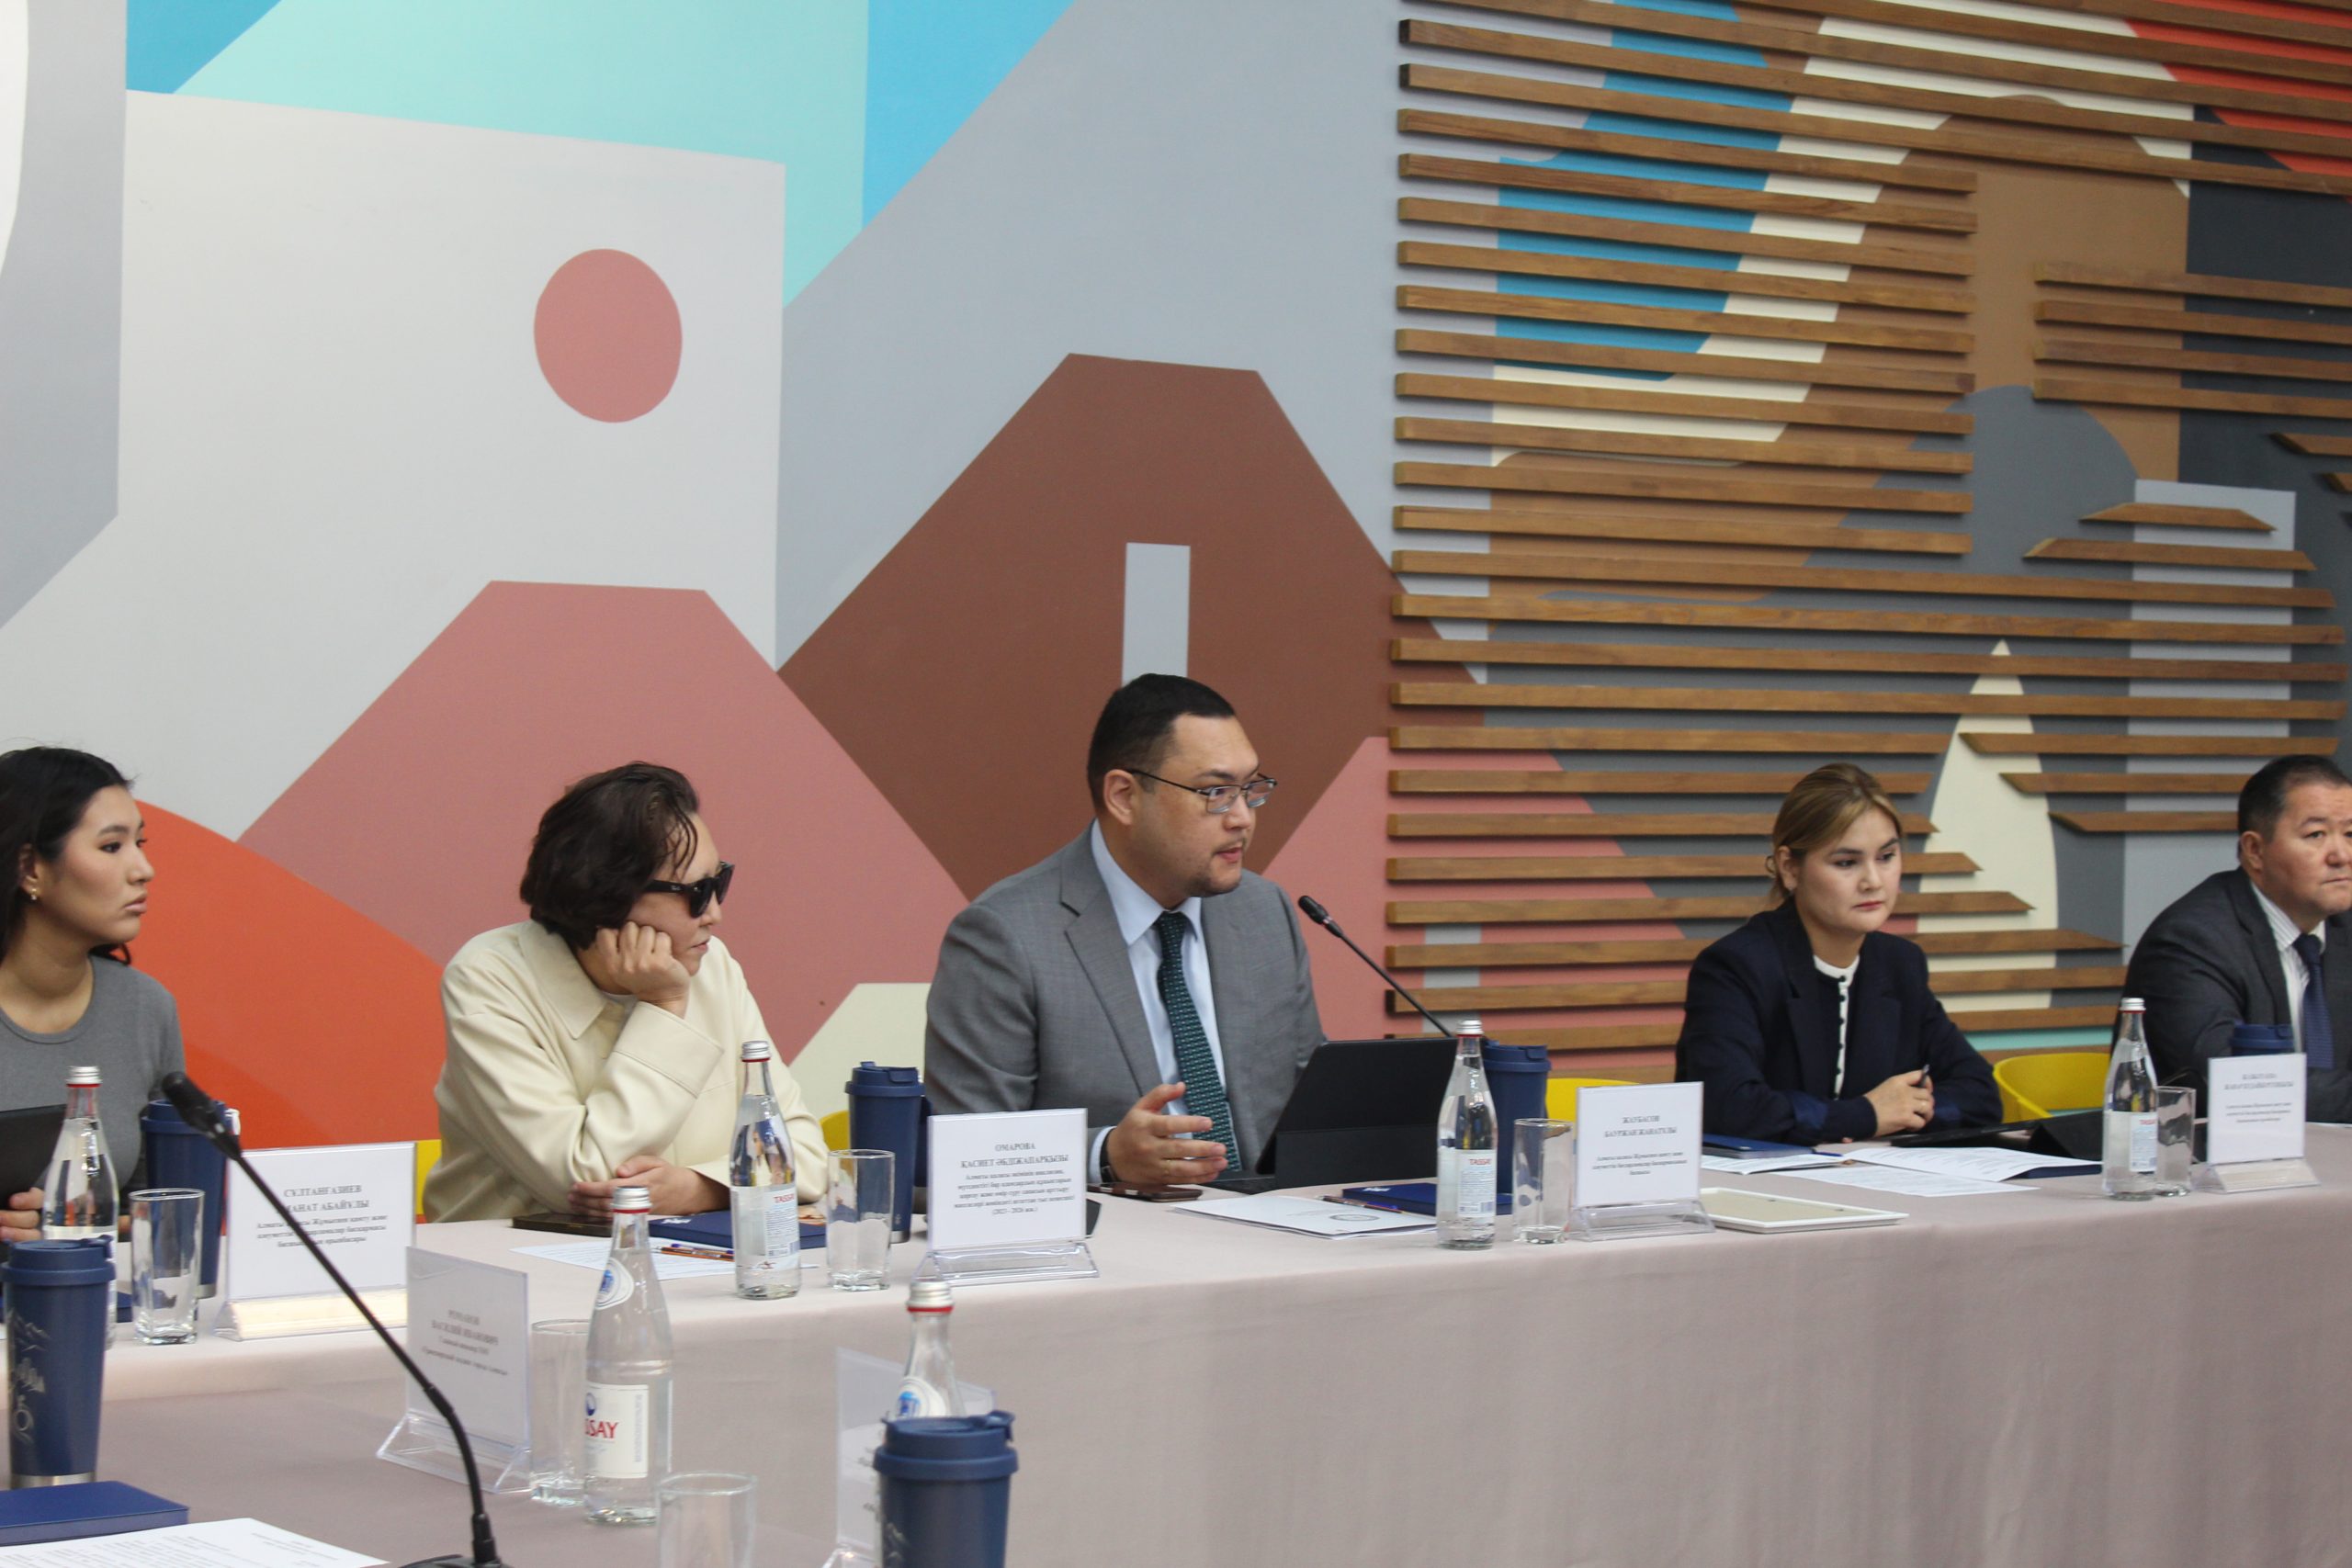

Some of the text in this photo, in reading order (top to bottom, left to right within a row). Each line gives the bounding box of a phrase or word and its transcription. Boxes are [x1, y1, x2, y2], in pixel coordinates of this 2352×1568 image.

[995, 1142, 1035, 1152] ОМАРОВА
[283, 1185, 363, 1198] СҰЛТАНҒАЗИЕВ
[322, 1200, 370, 1212] АБАЙҰЛЫ
